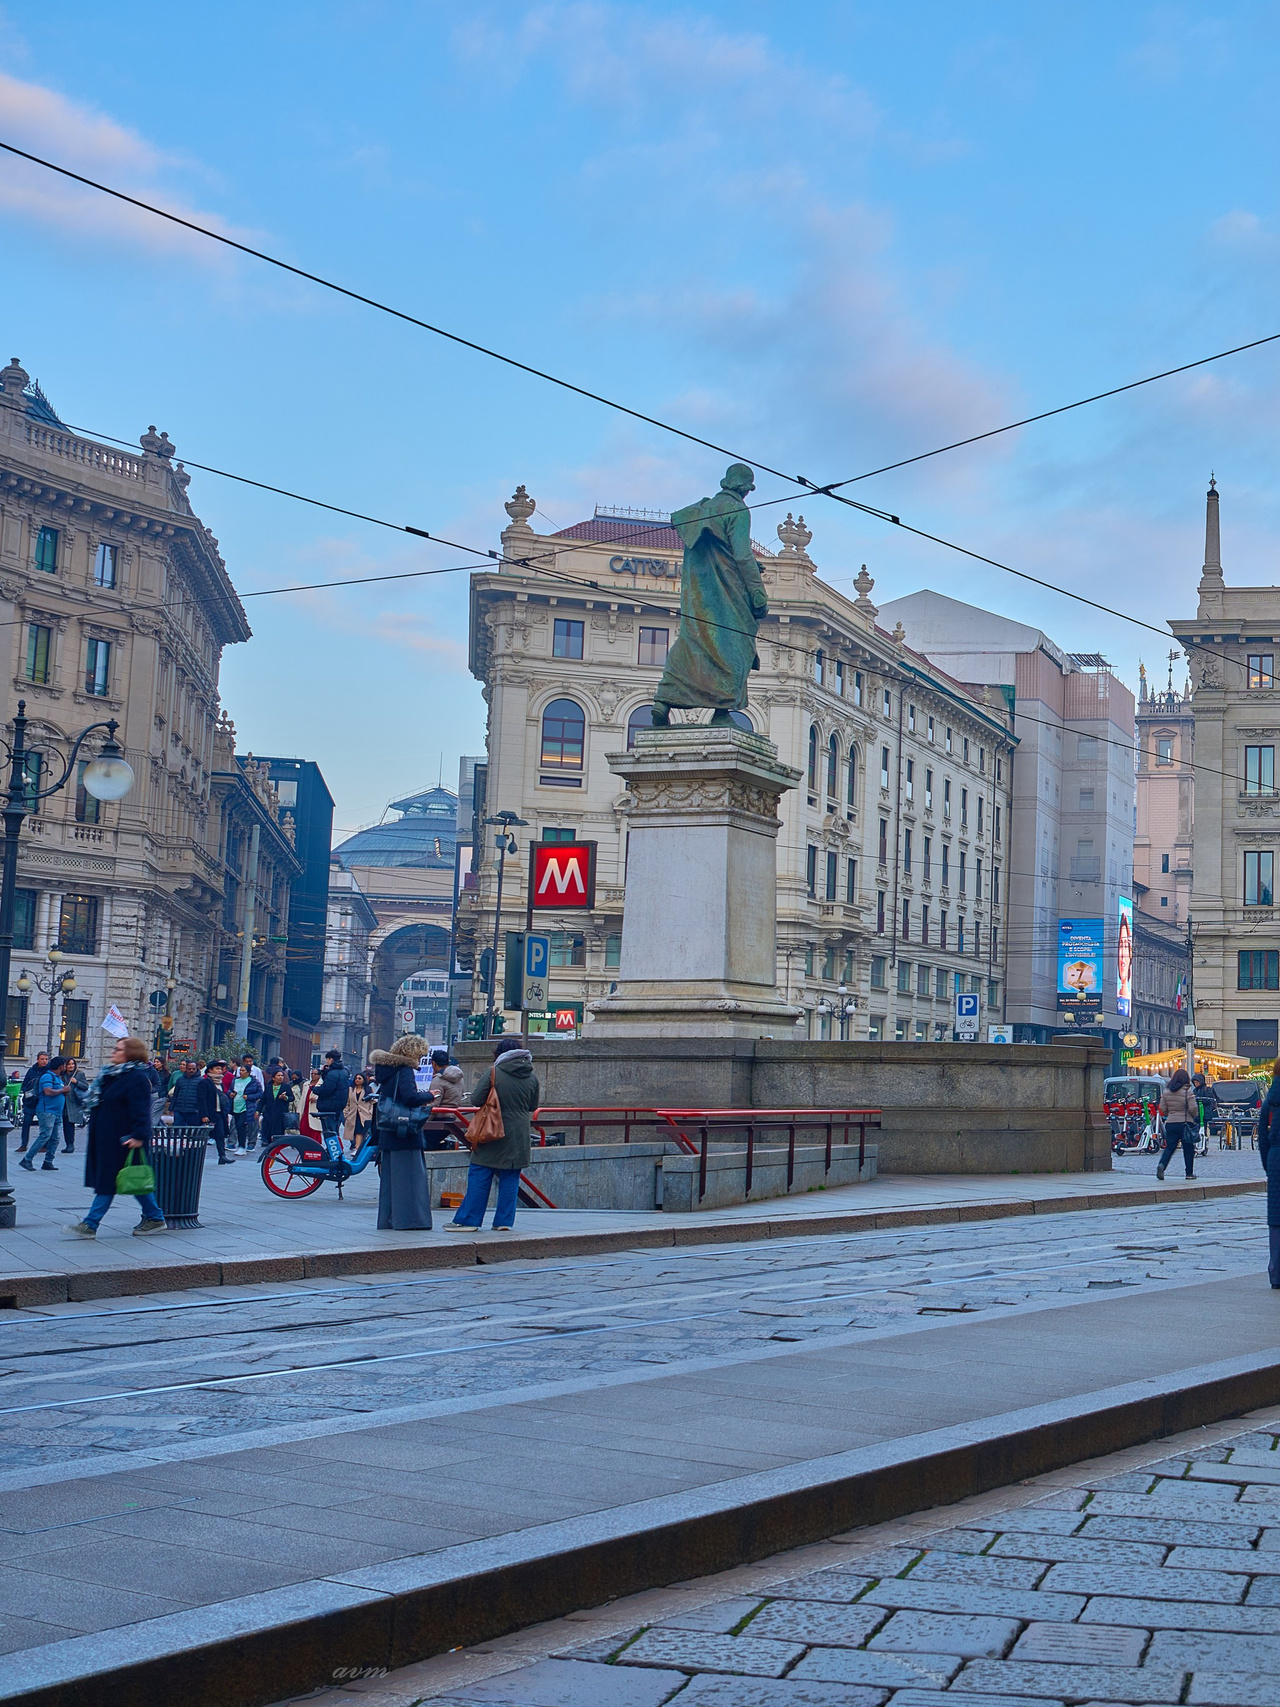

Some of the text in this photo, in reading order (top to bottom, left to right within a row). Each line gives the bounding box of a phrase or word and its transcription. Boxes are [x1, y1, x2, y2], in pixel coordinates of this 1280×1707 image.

[609, 555, 683, 579] CATTOLI
[538, 858, 585, 893] M
[531, 943, 544, 972] P
[962, 998, 974, 1014] P
[557, 1013, 574, 1025] M
